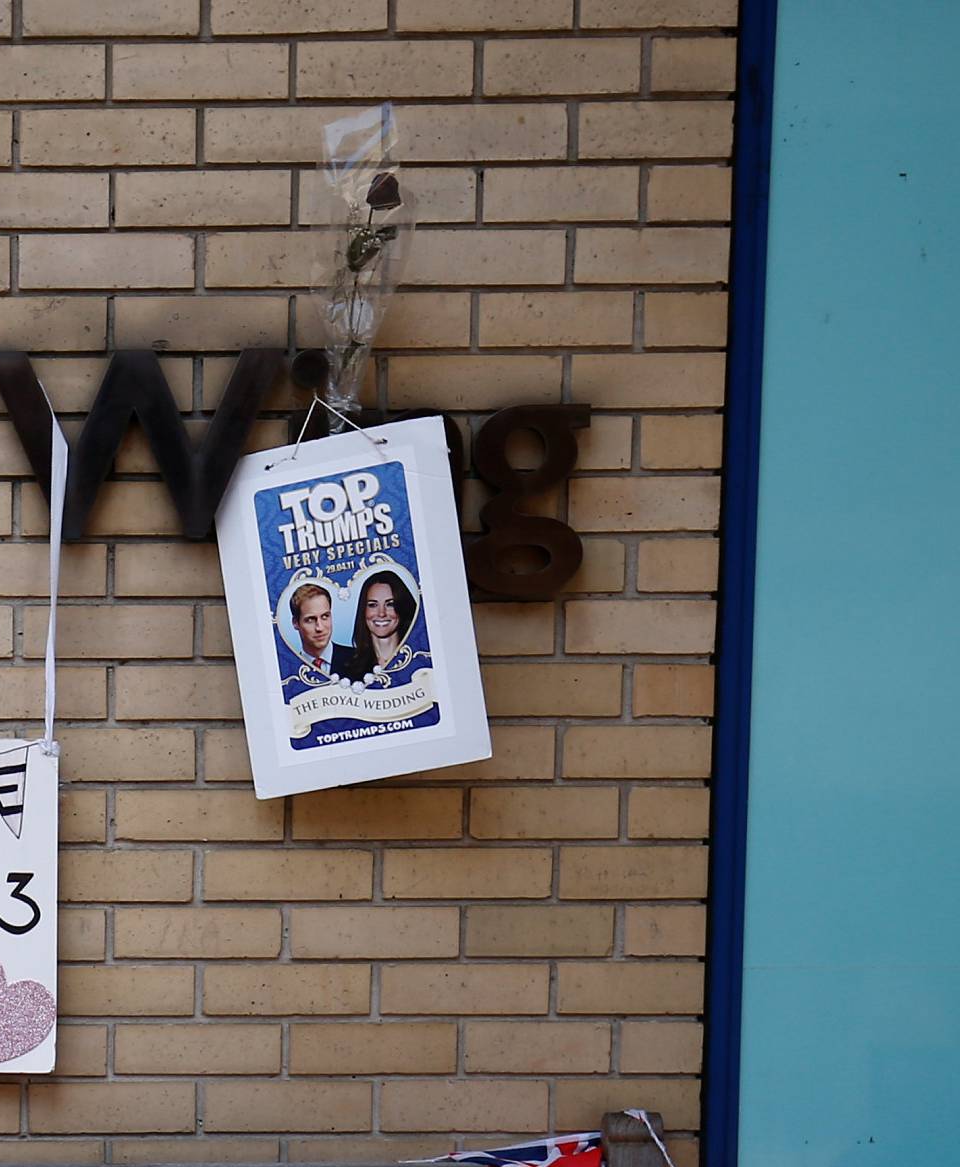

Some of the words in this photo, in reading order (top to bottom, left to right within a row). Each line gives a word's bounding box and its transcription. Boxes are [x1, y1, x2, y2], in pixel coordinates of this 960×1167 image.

[279, 471, 380, 530] TOP
[278, 502, 394, 554] TRUMPS
[282, 549, 322, 570] VERY
[326, 533, 401, 561] SPECIALS
[325, 561, 355, 574] 29.04.11
[293, 699, 319, 716] THE
[322, 695, 360, 709] ROYAL
[363, 687, 426, 711] WEDDING
[316, 719, 415, 745] TOPTRUMPS.COM
